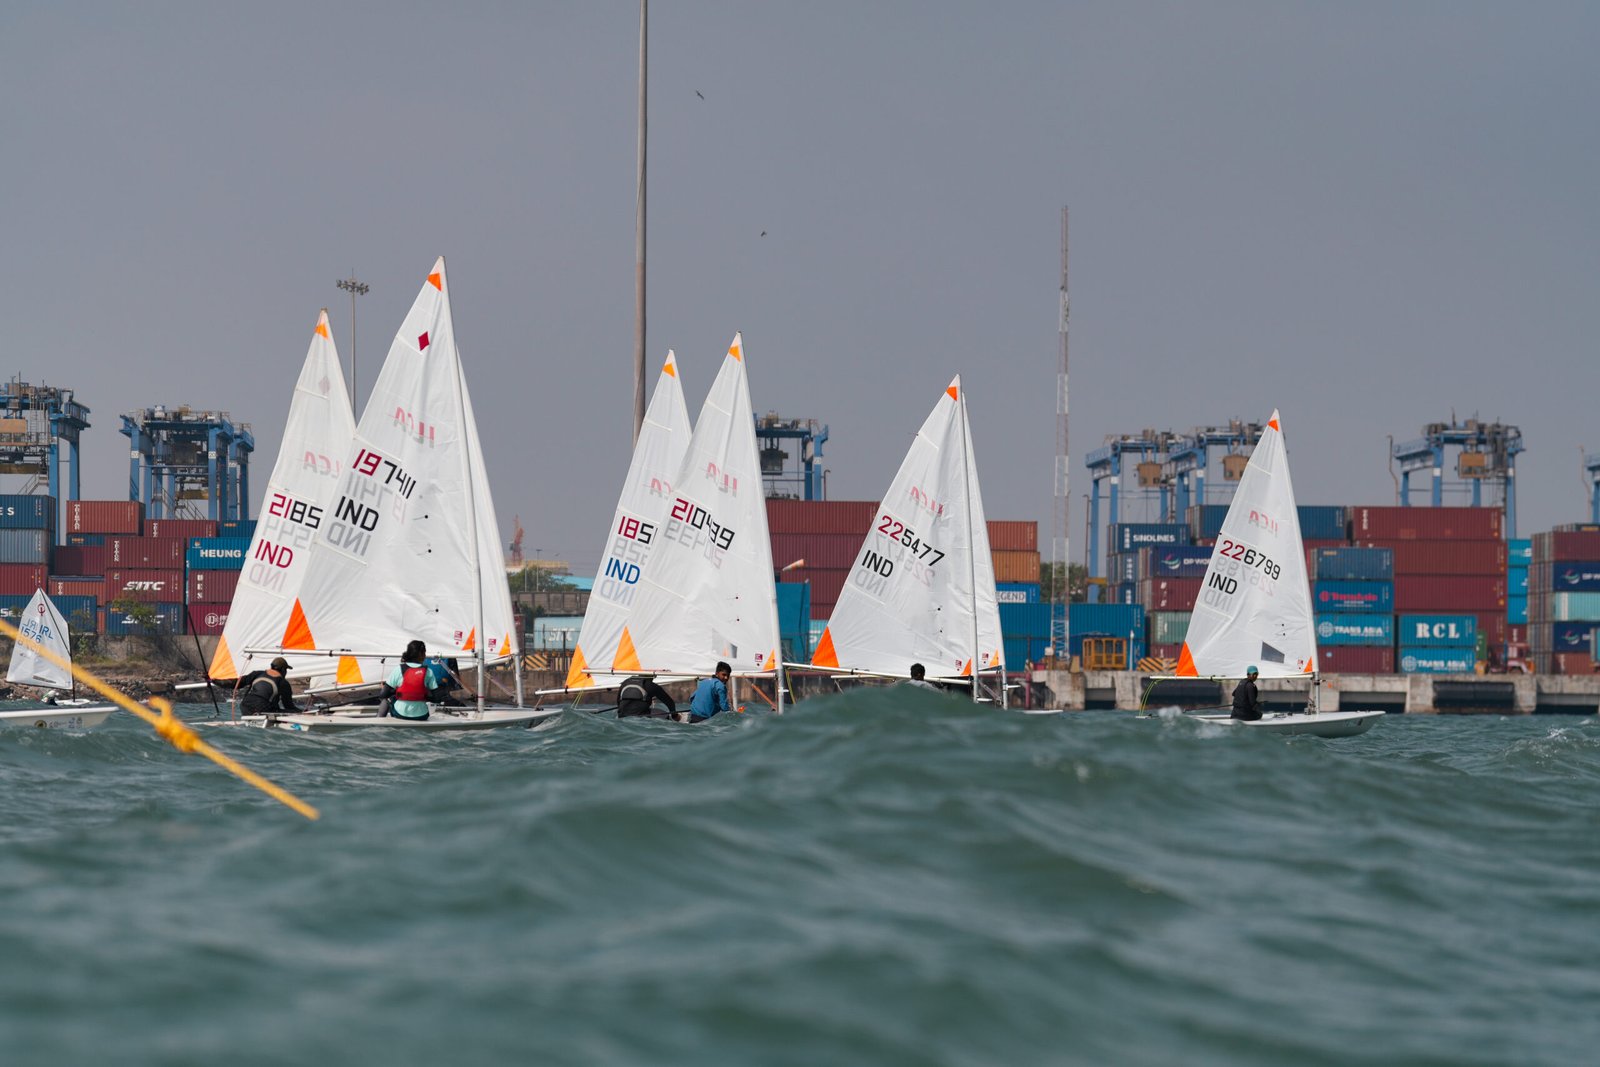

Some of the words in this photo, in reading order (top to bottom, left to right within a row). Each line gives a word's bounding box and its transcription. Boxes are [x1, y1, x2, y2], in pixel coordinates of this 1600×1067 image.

[352, 449, 416, 499] 197411
[335, 496, 379, 531] IND
[671, 498, 735, 550] 210439
[200, 549, 242, 558] HEUNG
[255, 539, 293, 568] IND
[878, 515, 945, 566] 225477
[605, 557, 640, 584] IND
[862, 550, 893, 578] IND
[1220, 540, 1280, 580] 226799
[122, 581, 165, 590] SITC
[1208, 572, 1237, 595] IND
[20, 626, 42, 644] 1576
[39, 624, 54, 639] IRL
[1416, 623, 1460, 638] RCL
